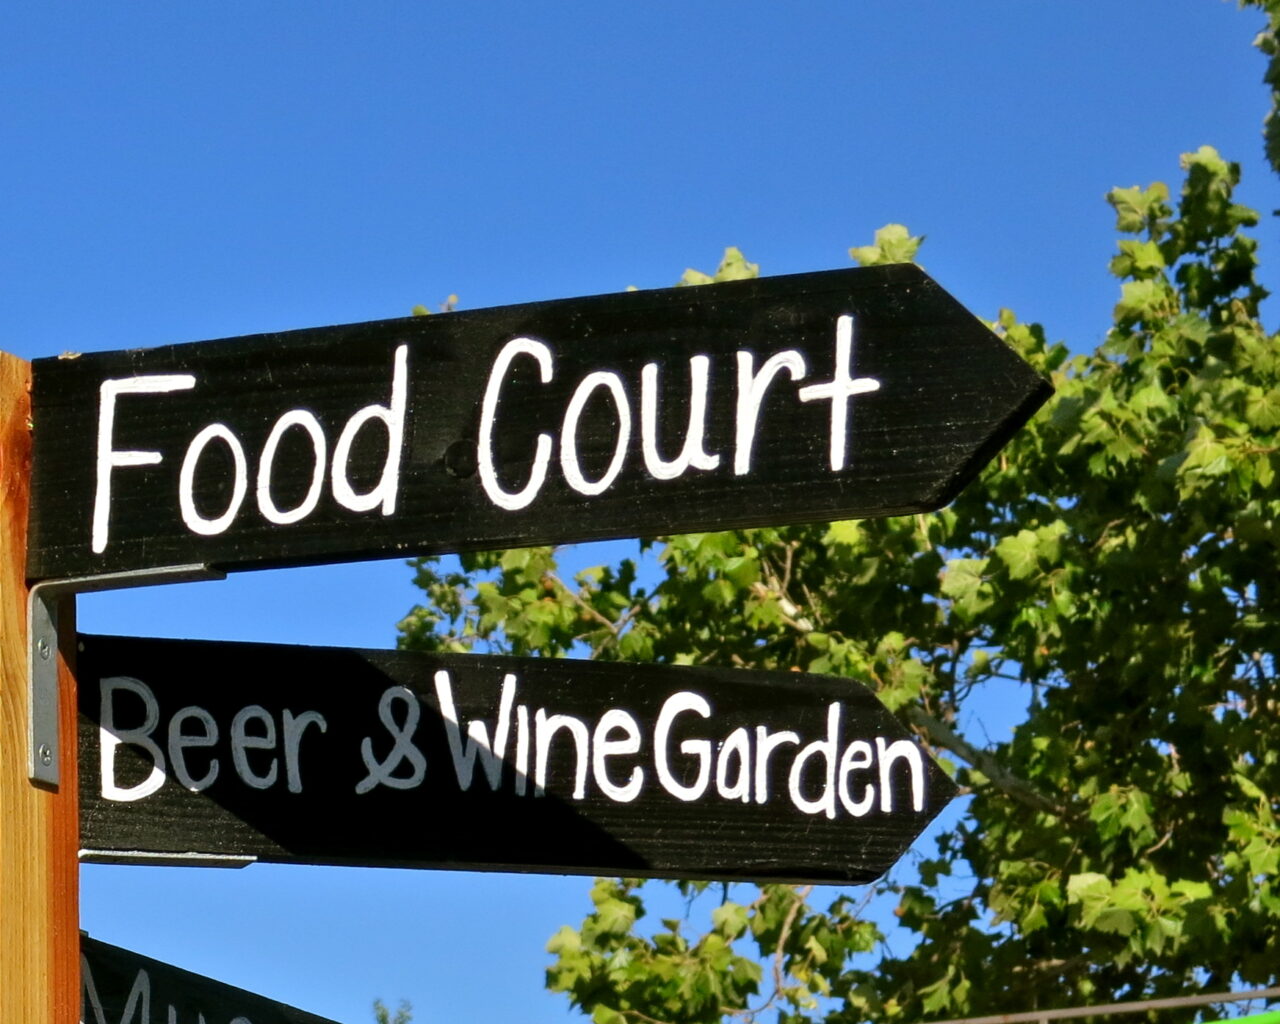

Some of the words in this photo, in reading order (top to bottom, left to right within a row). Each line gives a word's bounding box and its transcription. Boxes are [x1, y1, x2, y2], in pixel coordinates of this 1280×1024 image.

[91, 345, 408, 553] Food
[478, 314, 881, 511] Court
[99, 676, 327, 801] Beer
[354, 686, 426, 794] &
[655, 691, 922, 819] Garden
